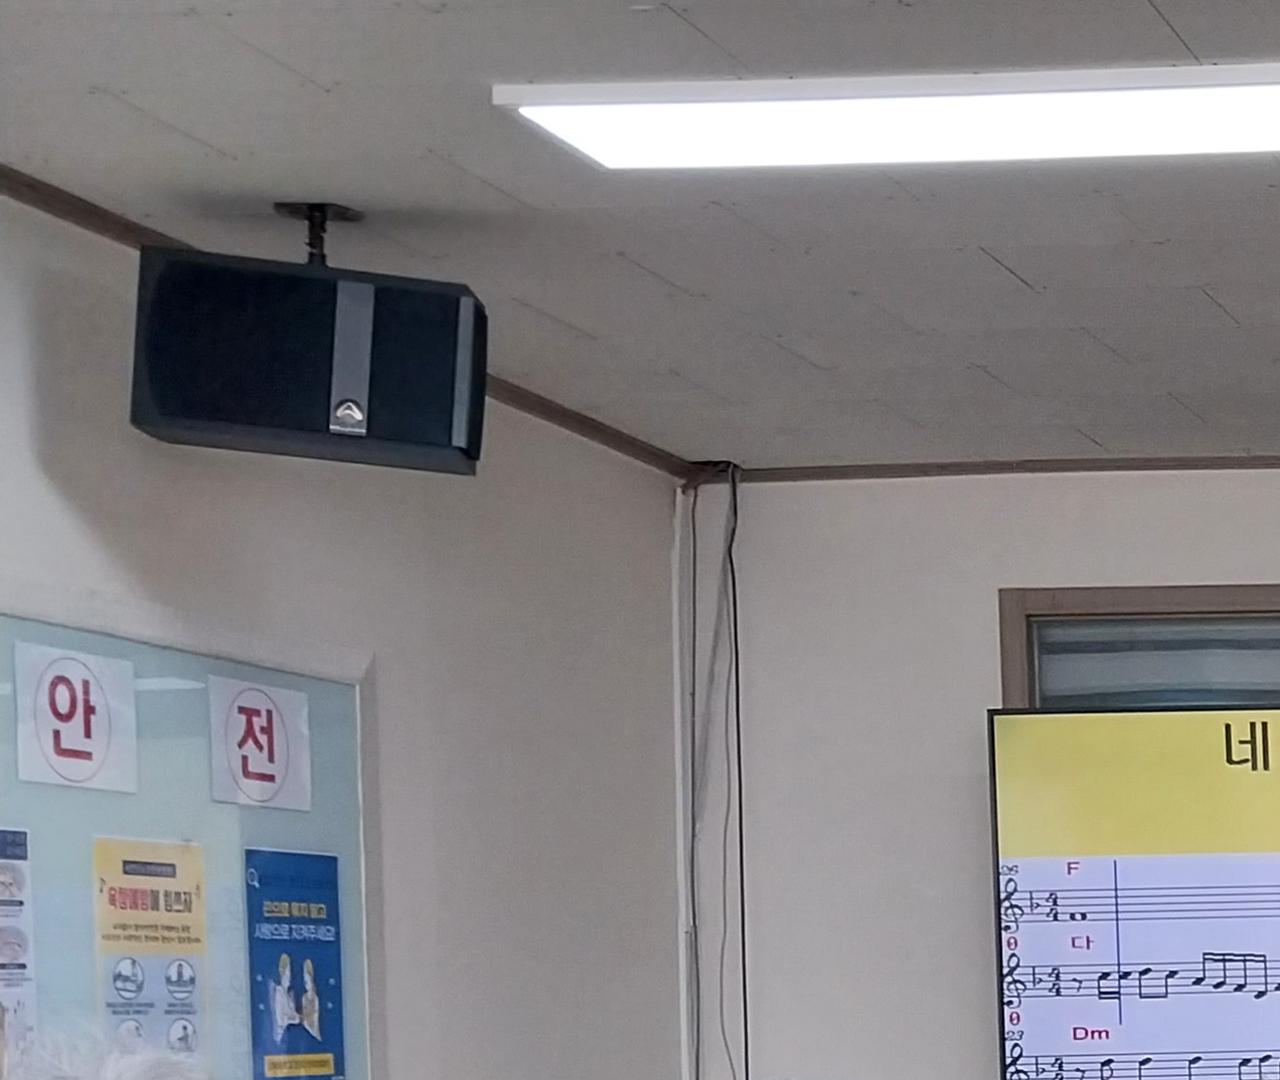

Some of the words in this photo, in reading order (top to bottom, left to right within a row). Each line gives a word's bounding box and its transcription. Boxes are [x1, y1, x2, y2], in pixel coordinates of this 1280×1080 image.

[48, 673, 96, 762] 안
[236, 704, 277, 784] 전
[1223, 720, 1272, 772] 네
[1066, 861, 1081, 876] F
[1071, 935, 1095, 950] 다
[1072, 1026, 1110, 1041] Dm
